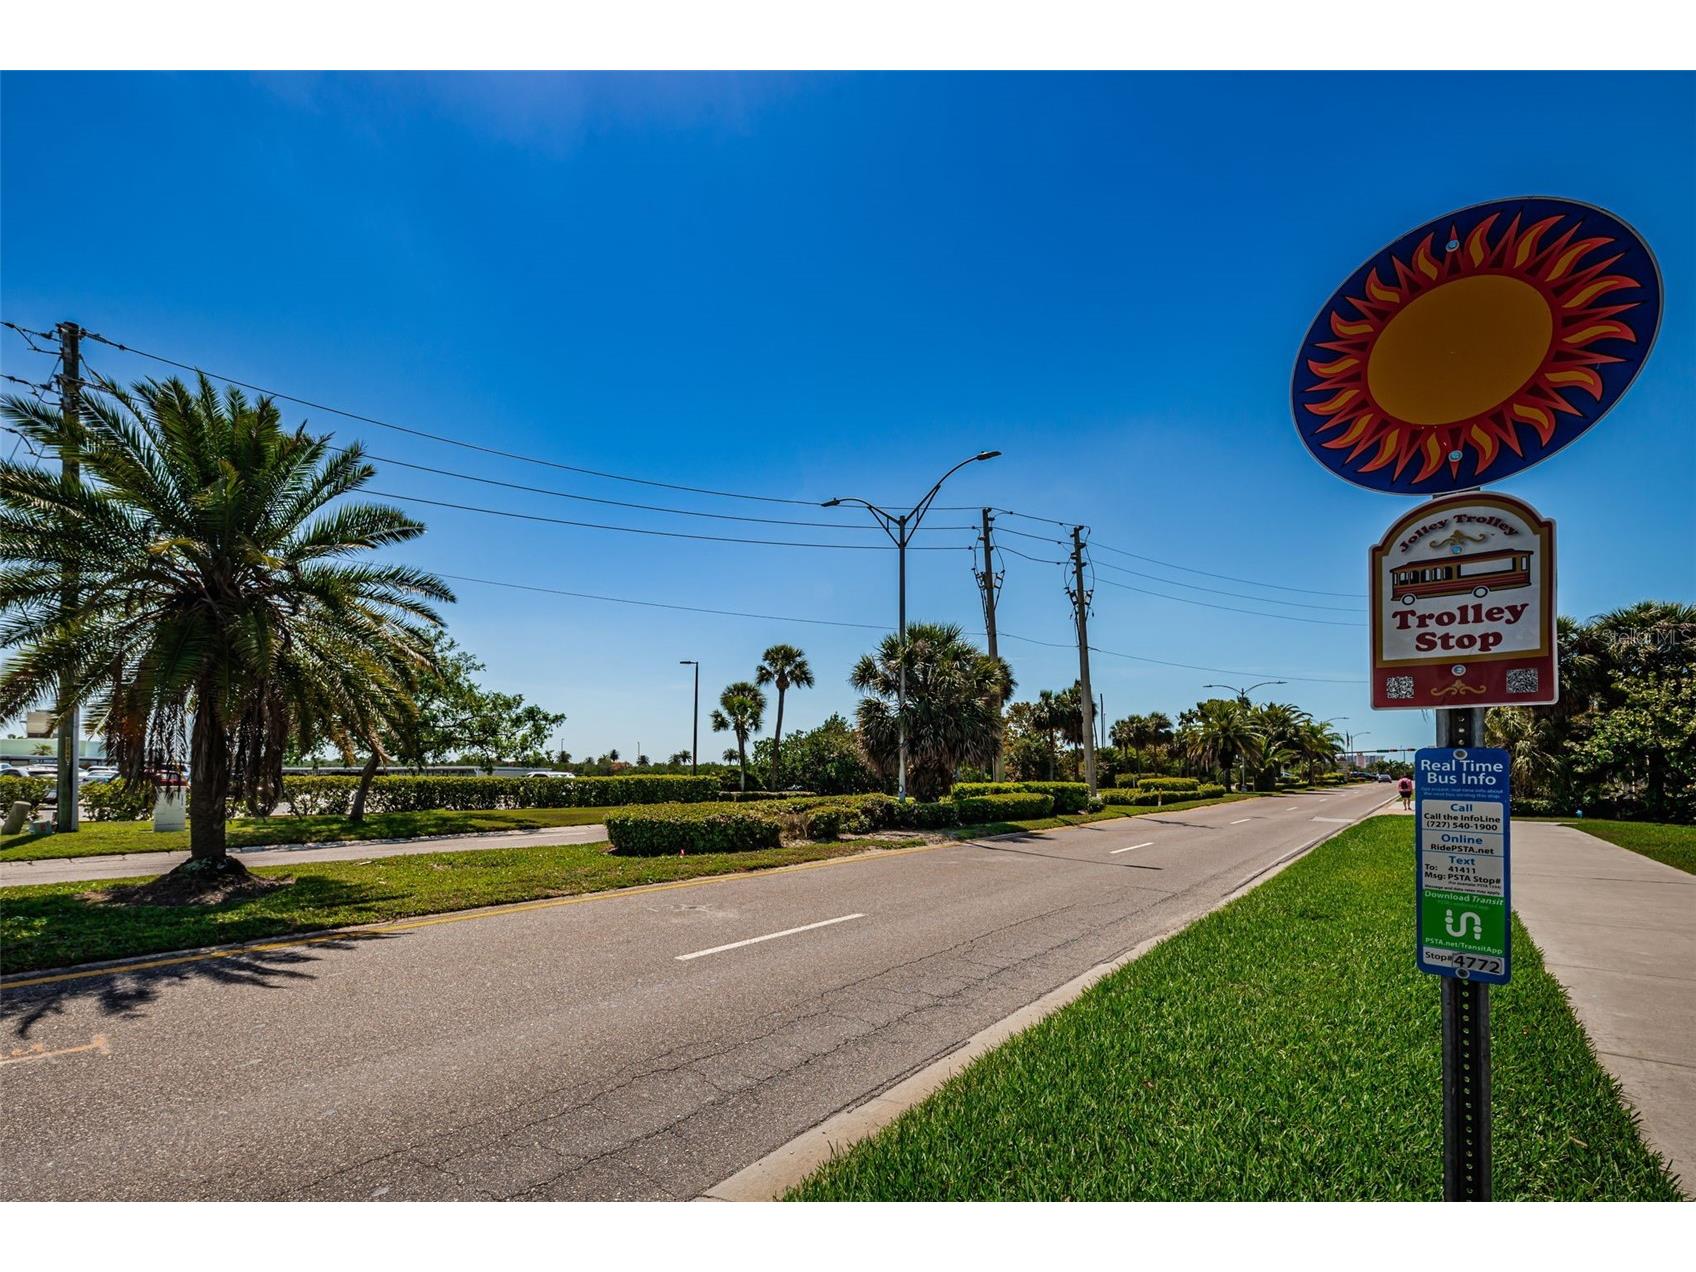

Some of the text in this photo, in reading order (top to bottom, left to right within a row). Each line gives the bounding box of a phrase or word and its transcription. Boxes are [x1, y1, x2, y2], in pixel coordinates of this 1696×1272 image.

[1399, 514, 1519, 552] Jolley Trolley
[1392, 602, 1530, 630] Trolley
[1415, 631, 1503, 652] Stop
[1421, 759, 1504, 773] Real Time
[1427, 772, 1497, 785] Bus Info
[1450, 803, 1473, 812] Call
[1426, 820, 1498, 831] (727) 540-1900
[1460, 815, 1501, 823] InfoLine
[1441, 833, 1483, 845] Online
[1430, 843, 1495, 855] RidePSTA.net
[1449, 856, 1476, 866] Text
[1424, 863, 1476, 874] To: 41411
[1424, 871, 1446, 880] Msg:
[1447, 873, 1471, 882] PSTA
[1473, 876, 1501, 885] Stop#
[1424, 890, 1470, 902] Download
[1472, 895, 1504, 906] Transit
[1425, 937, 1503, 955] PSTA.net/TransitApp
[1424, 951, 1500, 974] Stop# 4772
